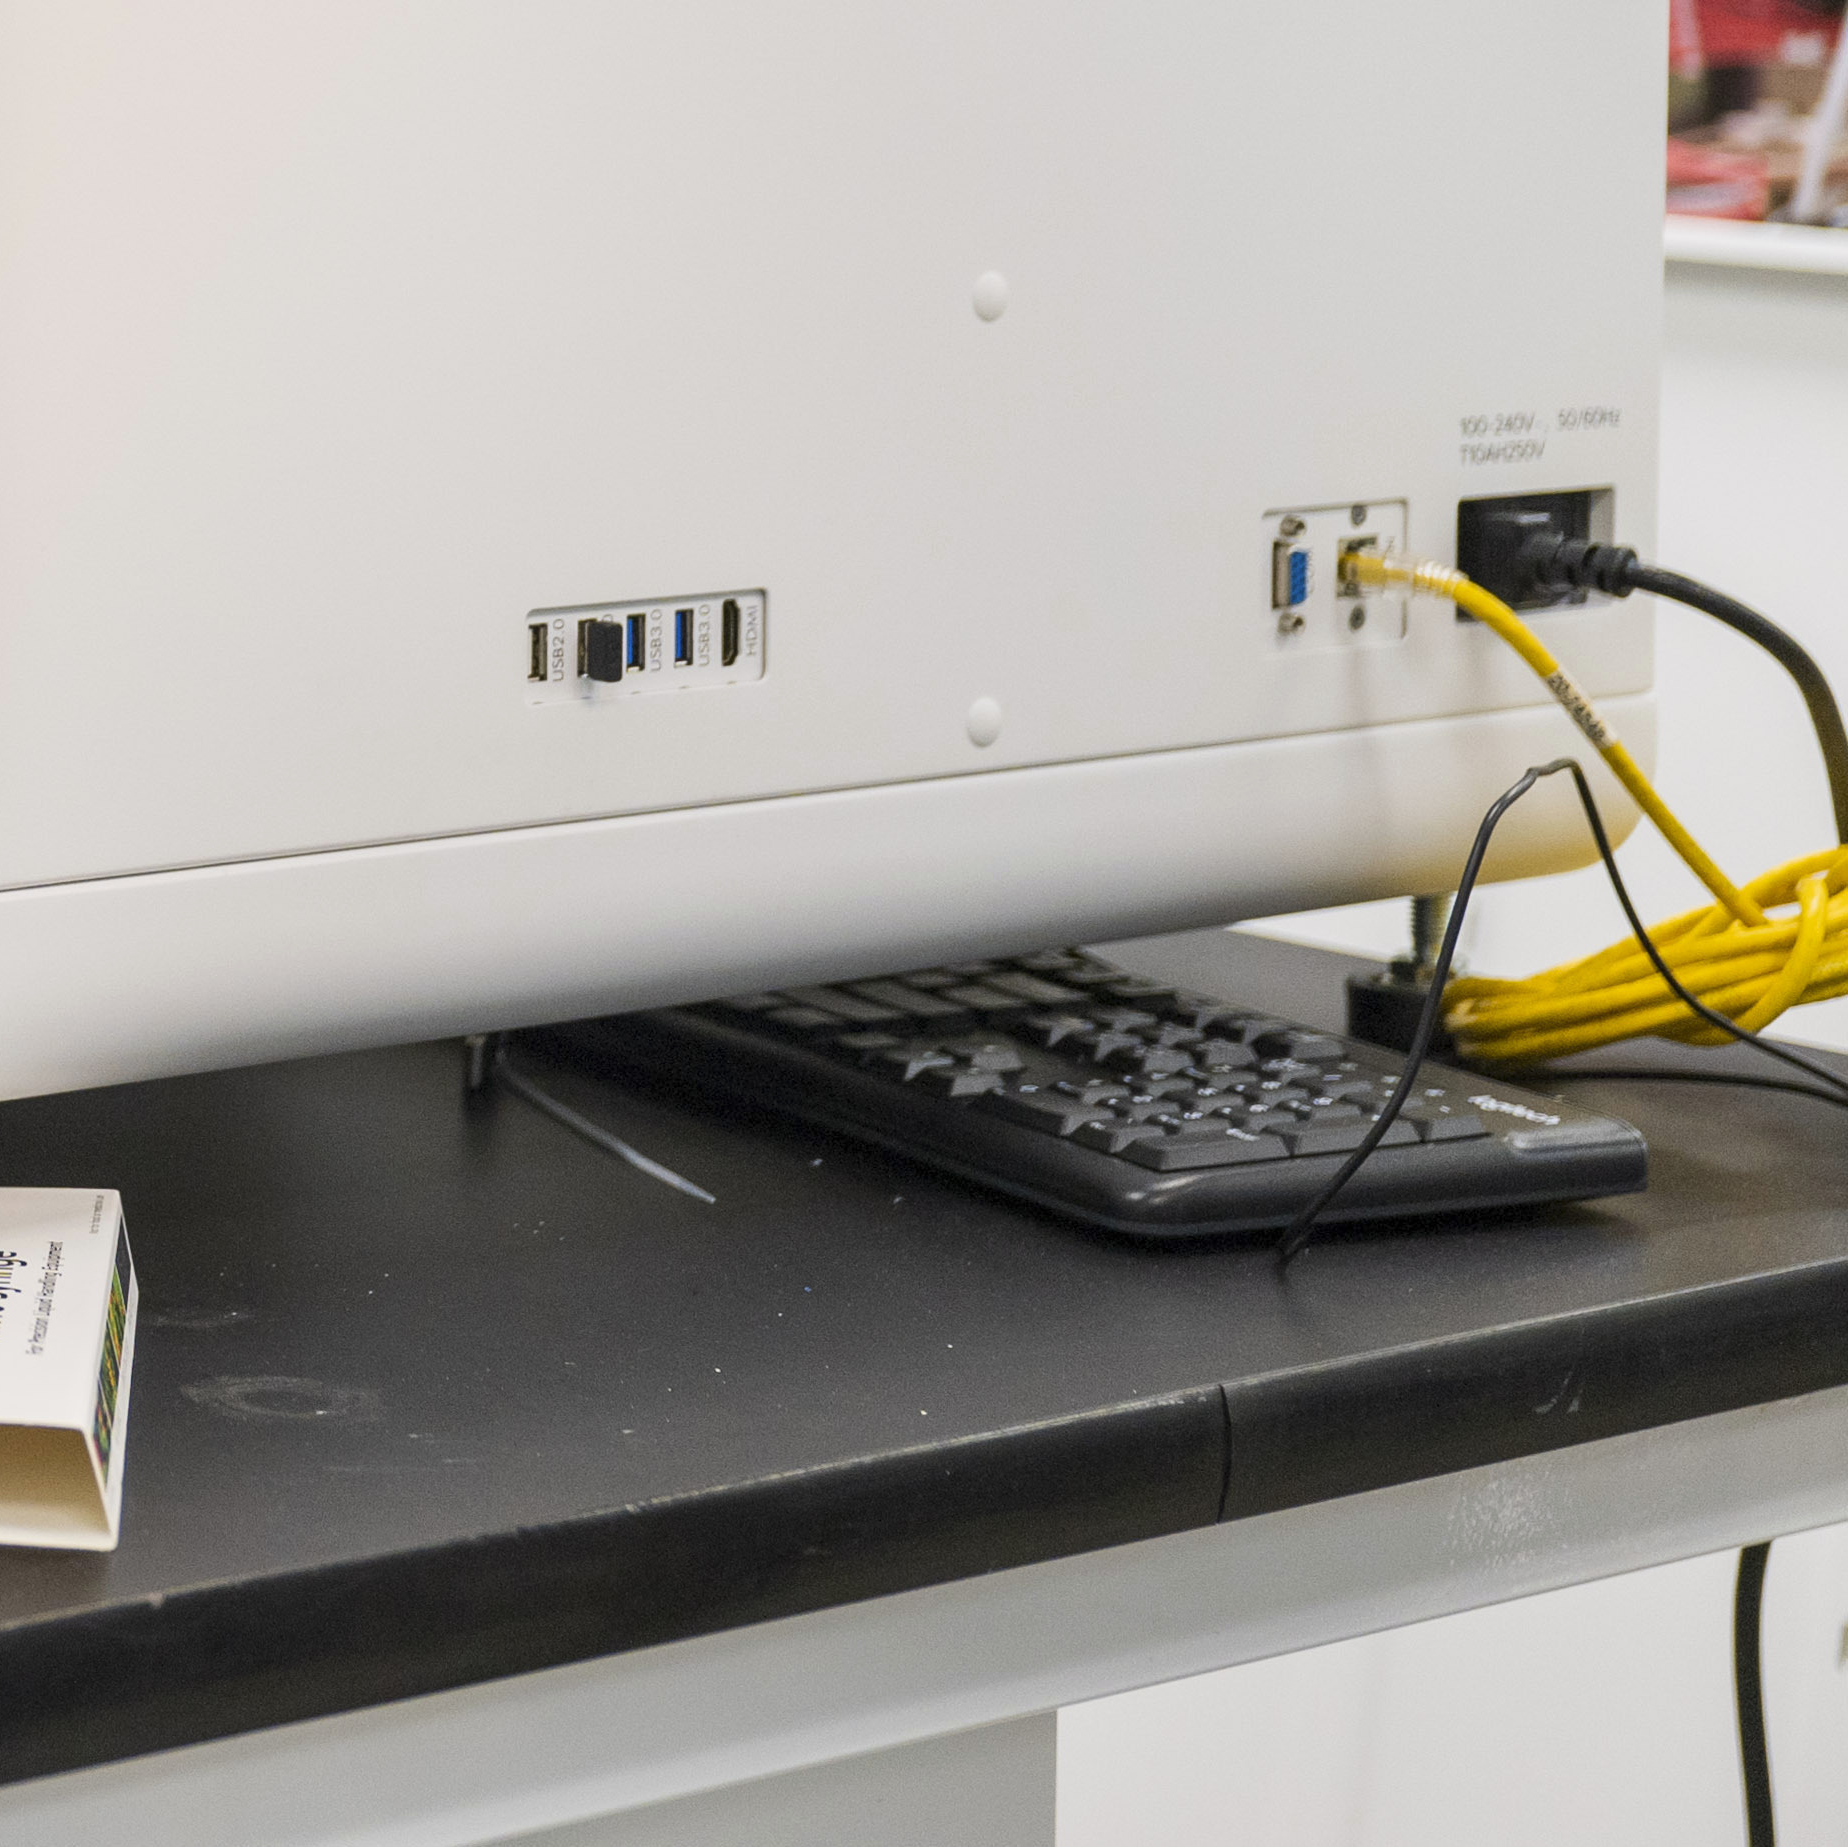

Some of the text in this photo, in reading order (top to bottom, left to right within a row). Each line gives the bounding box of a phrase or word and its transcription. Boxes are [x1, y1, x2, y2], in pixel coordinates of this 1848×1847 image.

[552, 618, 565, 682] USB2.0
[650, 608, 663, 672] USB3.0
[698, 604, 711, 667] USB3.0
[747, 605, 759, 657] HDMI
